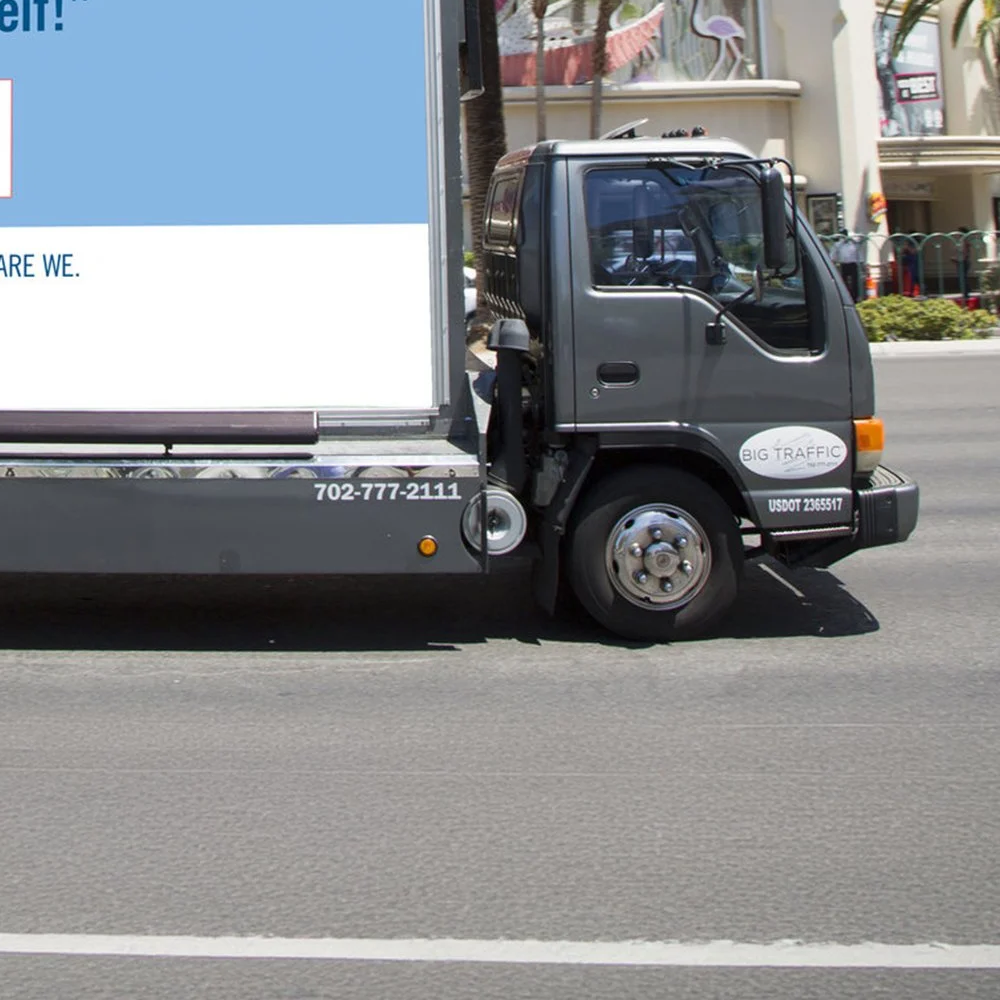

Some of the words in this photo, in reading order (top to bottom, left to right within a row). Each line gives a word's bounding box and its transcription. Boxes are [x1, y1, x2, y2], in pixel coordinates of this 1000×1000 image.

[43, 254, 79, 277] WE.
[742, 448, 769, 462] BIG
[774, 446, 841, 460] TRAFFIC
[314, 483, 461, 500] 702-777-2111
[769, 499, 801, 512] USDOT
[803, 498, 843, 511] 2365517
